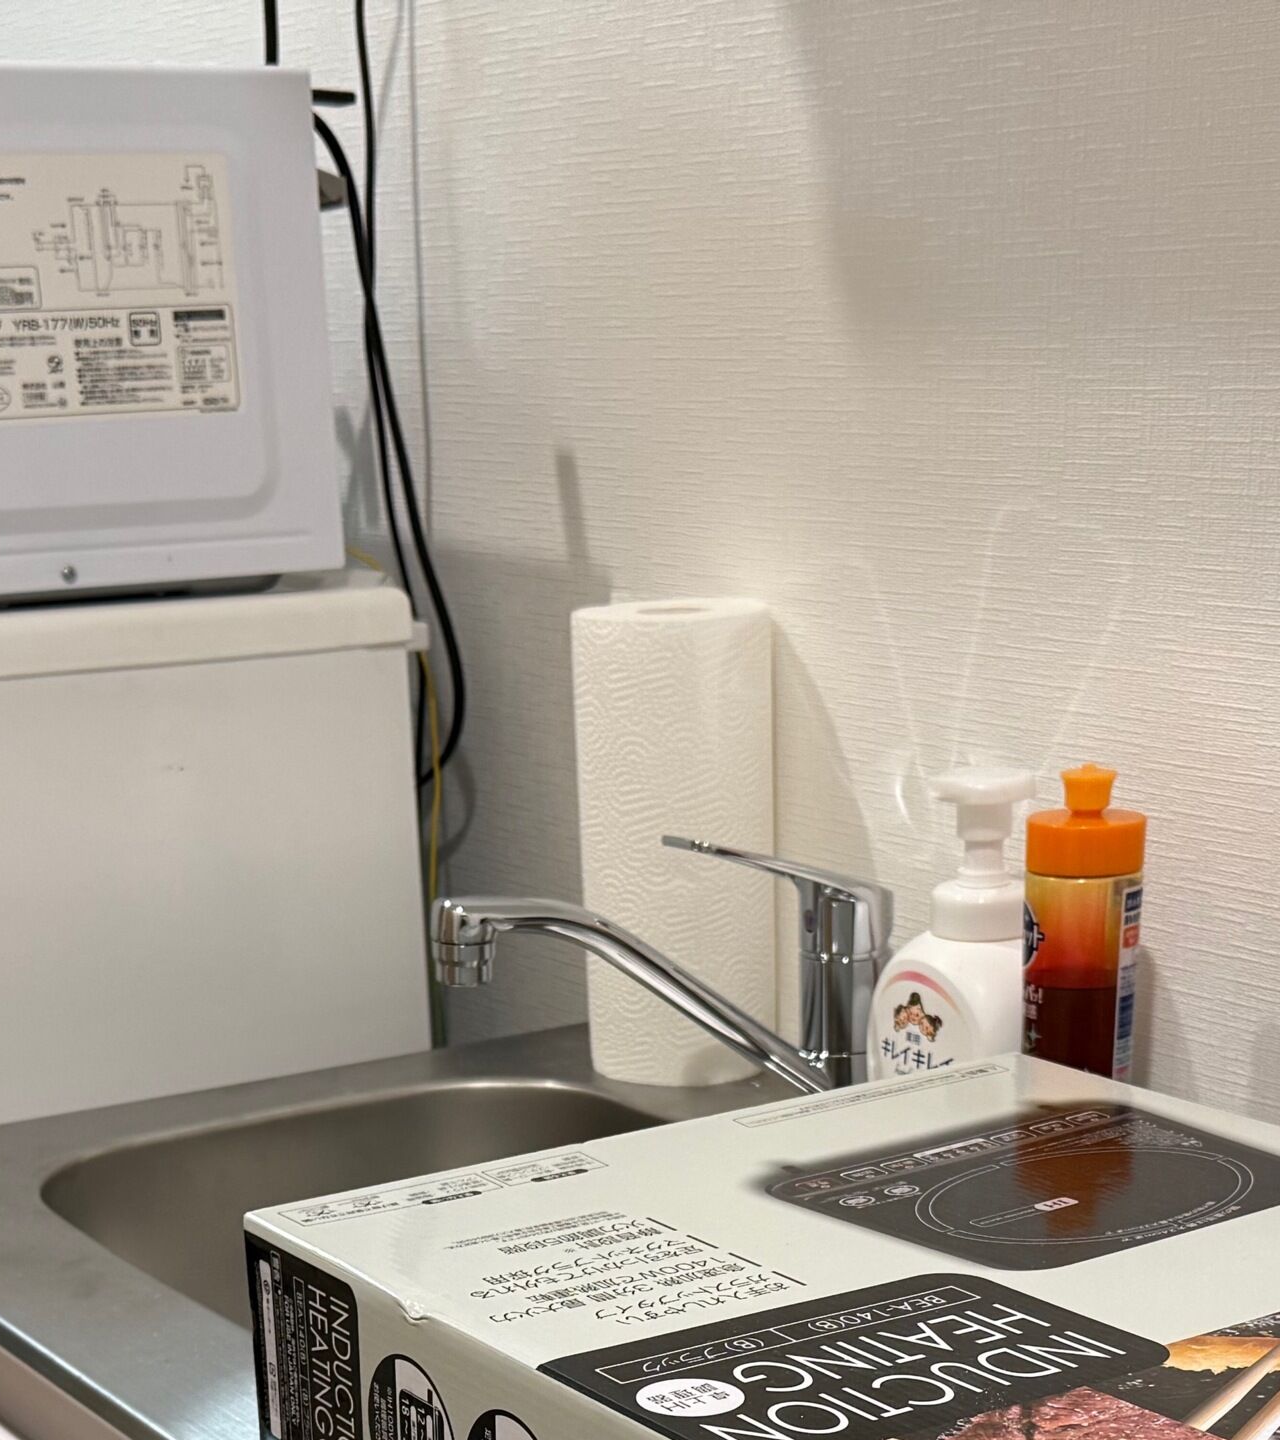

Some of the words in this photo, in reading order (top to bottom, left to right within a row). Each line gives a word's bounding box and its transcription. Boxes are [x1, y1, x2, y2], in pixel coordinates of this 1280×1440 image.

[465, 1242, 706, 1303] 足を引っかけても外れる
[479, 1235, 687, 1286] マグネットプラグ採用
[649, 1261, 749, 1288] 急速加熱
[282, 1292, 290, 1318] FOR
[583, 1281, 657, 1303] 3分間
[584, 1271, 775, 1322] ガラストップタイプ
[612, 1279, 794, 1328] お手入れしやすい
[484, 1296, 589, 1325] 最大火力
[800, 1292, 948, 1334] BEA-140(B)
[285, 1341, 292, 1356] IN
[306, 1282, 334, 1440] HEATING
[717, 1302, 1053, 1397] HEATING
[286, 1355, 295, 1396] JAPAN
[400, 1395, 409, 1417] 18
[642, 1381, 720, 1405] 調理器
[657, 1388, 733, 1412] 卓上IH
[416, 1404, 425, 1427] 12
